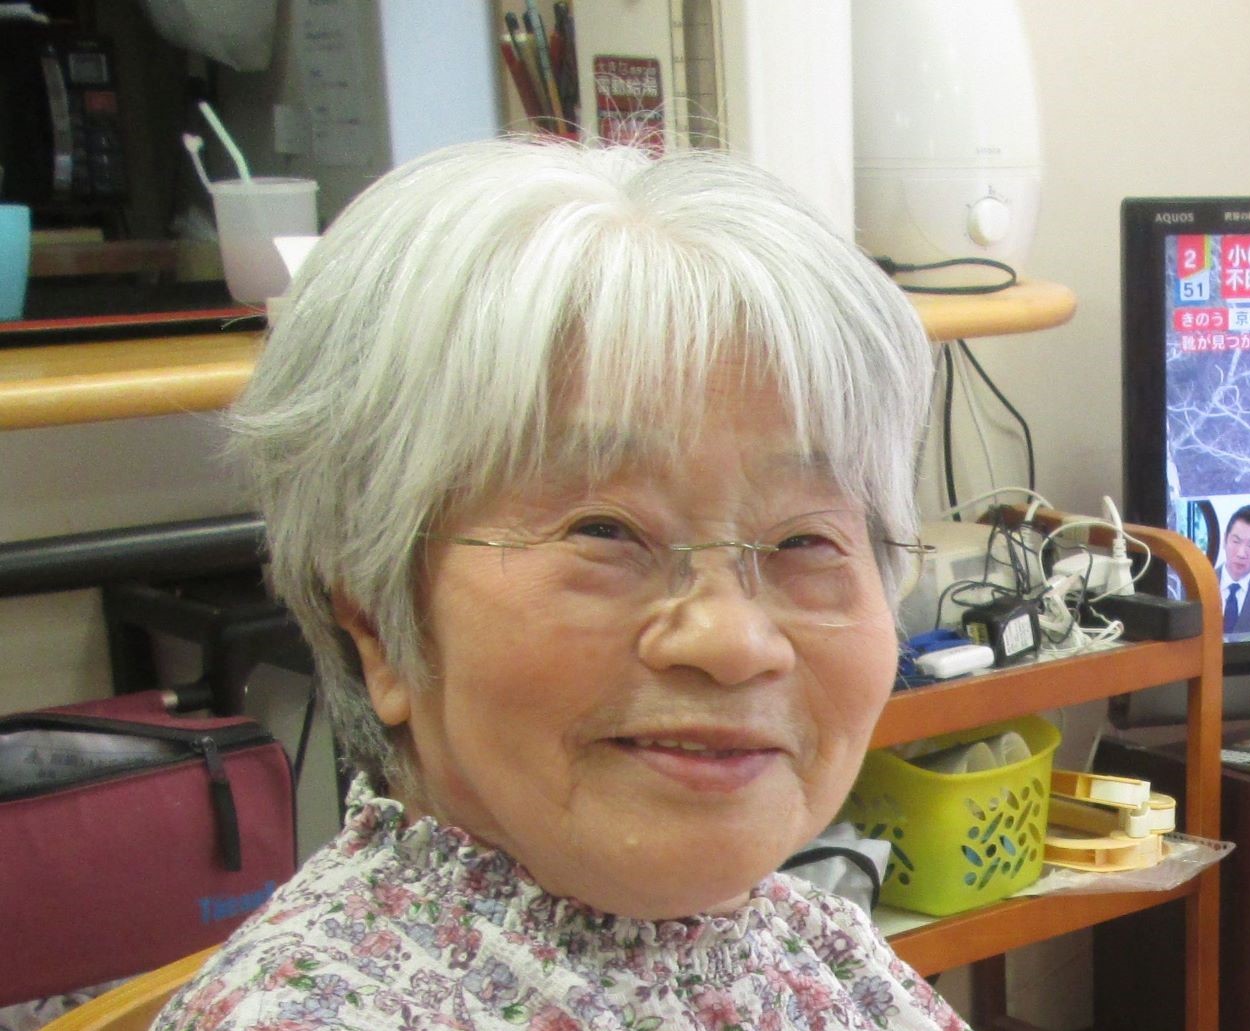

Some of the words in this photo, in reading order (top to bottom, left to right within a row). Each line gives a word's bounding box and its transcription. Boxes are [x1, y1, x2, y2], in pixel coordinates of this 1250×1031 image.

[1154, 212, 1195, 223] AQUOS
[1183, 249, 1197, 269] 2
[1182, 282, 1205, 298] 51
[1181, 312, 1224, 326] きのう
